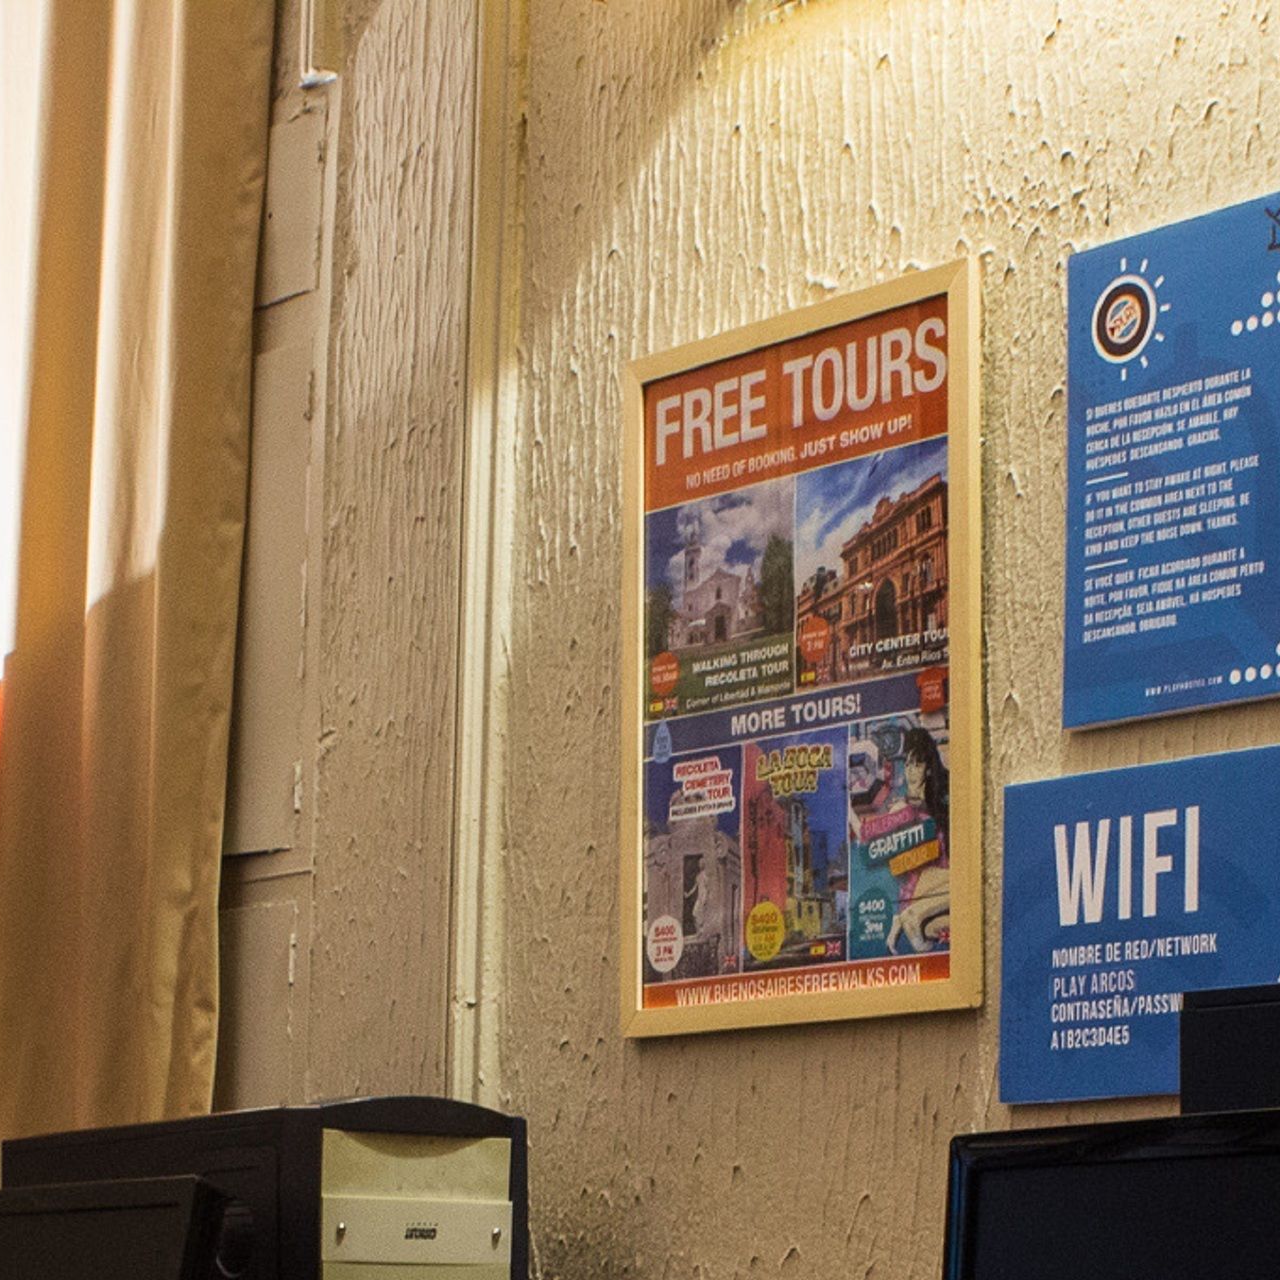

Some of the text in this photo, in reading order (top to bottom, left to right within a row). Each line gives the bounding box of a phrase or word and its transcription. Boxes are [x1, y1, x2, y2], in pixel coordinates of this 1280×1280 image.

[655, 317, 947, 466] FREE TOURS
[1204, 371, 1239, 389] DURANTE
[1241, 367, 1251, 380] LA
[686, 471, 700, 488] NO
[703, 465, 729, 484] NEED
[732, 459, 745, 478] OF
[800, 435, 836, 460] JUST
[840, 422, 883, 449] SHOW
[888, 414, 912, 437] UP!
[1121, 432, 1130, 444] LA
[1095, 489, 1110, 503] YOU
[1134, 481, 1143, 494] TO
[1144, 477, 1161, 491] STAY
[1192, 468, 1201, 480] AT
[1230, 454, 1259, 472] PLEASE
[1114, 502, 1128, 515] THE
[1164, 489, 1183, 504] AREA
[1184, 484, 1204, 500] NEXT
[1207, 482, 1216, 495] TO
[1218, 478, 1232, 492] THE
[1127, 514, 1151, 530] OTHER
[1153, 508, 1180, 524] GUESTS
[1183, 504, 1196, 517] ARE
[1103, 538, 1119, 552] AND
[1120, 534, 1139, 549] KEEP
[1140, 530, 1155, 544] THE
[1201, 549, 1236, 566] DURANTE
[1239, 547, 1244, 559] A
[849, 627, 948, 658] CITY CENTER TOU
[692, 653, 737, 674] WALKING
[740, 643, 789, 664] THROUGH
[705, 660, 789, 687] RECOLETA TOUR
[732, 692, 862, 736] MORE TOURS!
[756, 743, 833, 781] LA BOCA
[707, 786, 731, 800] TOUR
[770, 770, 818, 797] TOUR
[869, 824, 924, 859] GRAFFITI
[1054, 805, 1200, 927] WIFI
[1052, 933, 1217, 968] NOMBRE DE RED/NETWORK
[676, 964, 921, 1007] WWW.BUENOSAIRESFREEWALKS.COM
[1053, 969, 1134, 998] PLAY ARCOS
[1051, 992, 1184, 1023] CONTRASEÑA/PASSW
[1051, 1025, 1130, 1050] A1B2C3D4E5
